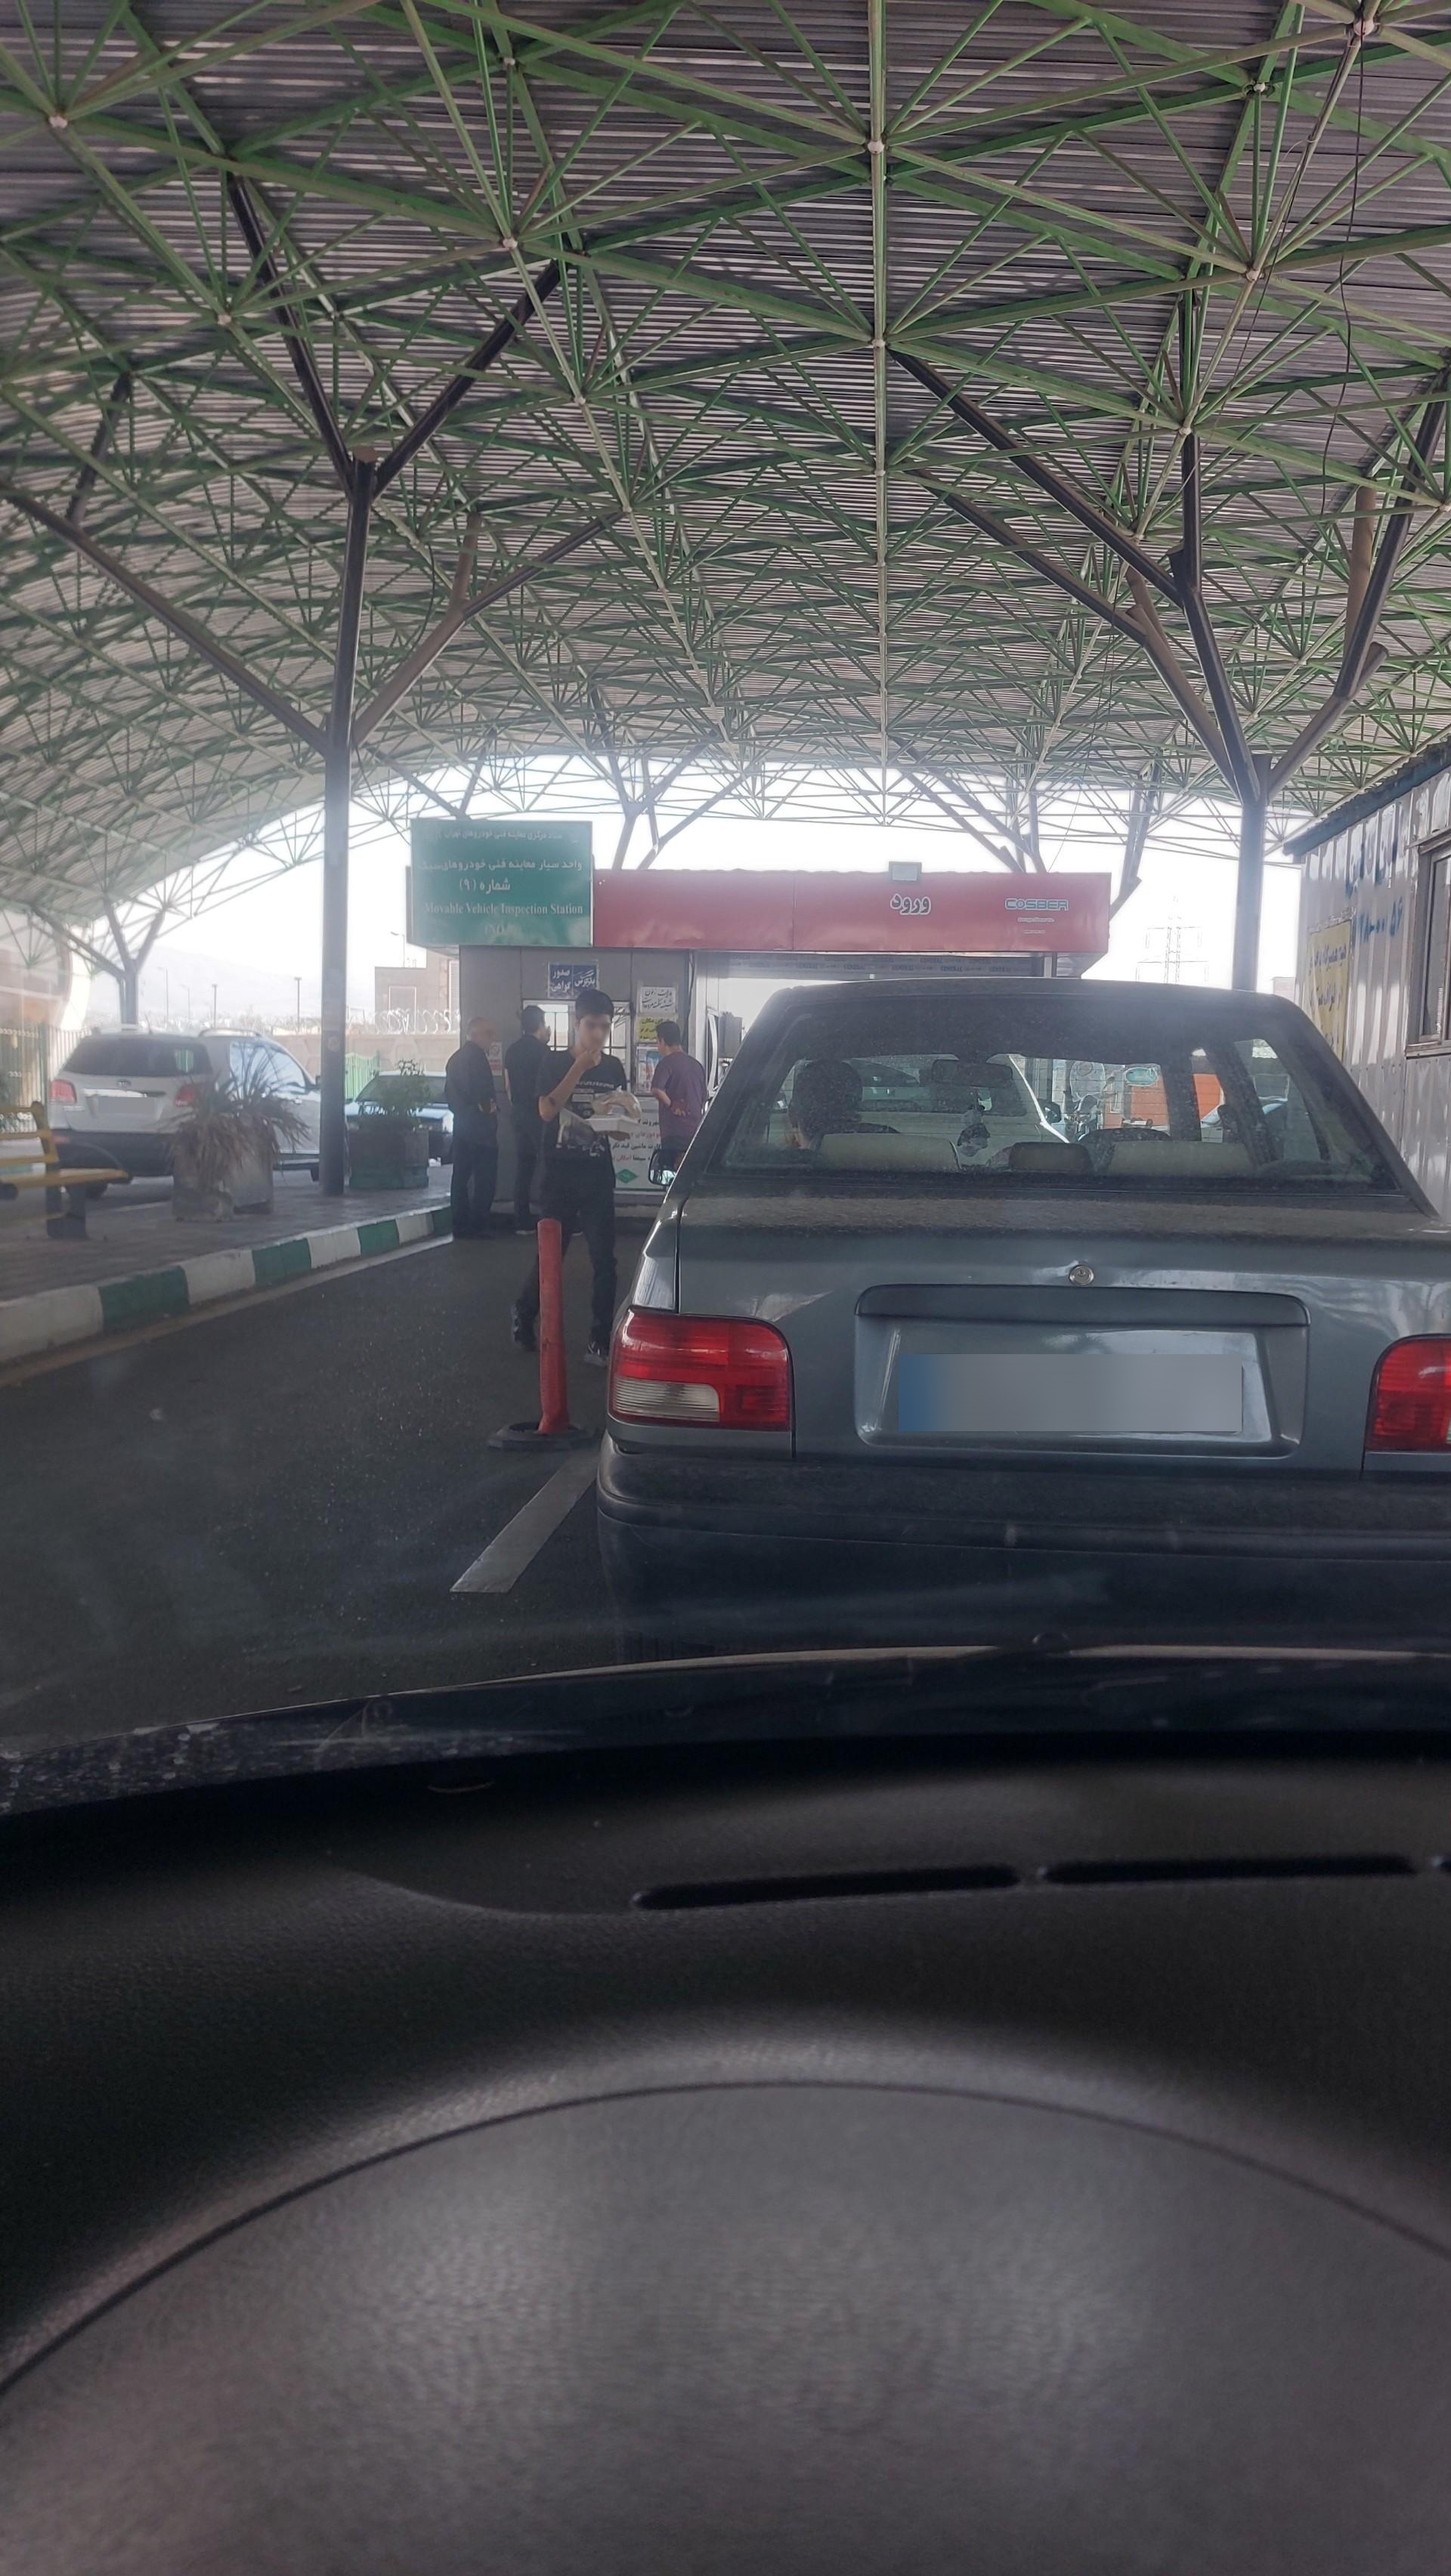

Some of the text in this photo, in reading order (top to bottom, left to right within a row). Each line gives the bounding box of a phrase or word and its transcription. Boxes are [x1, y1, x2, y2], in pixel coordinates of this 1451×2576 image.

[442, 859, 486, 871] خودروهای
[488, 859, 506, 871] فنی
[509, 861, 535, 871] معاینه
[539, 860, 559, 871] سیار
[562, 860, 583, 871] واحد
[479, 877, 511, 895] شماره
[424, 902, 583, 917] Movable Vehicle Inspection Station
[889, 892, 932, 916] ورود
[1005, 897, 1069, 912] COSBER
